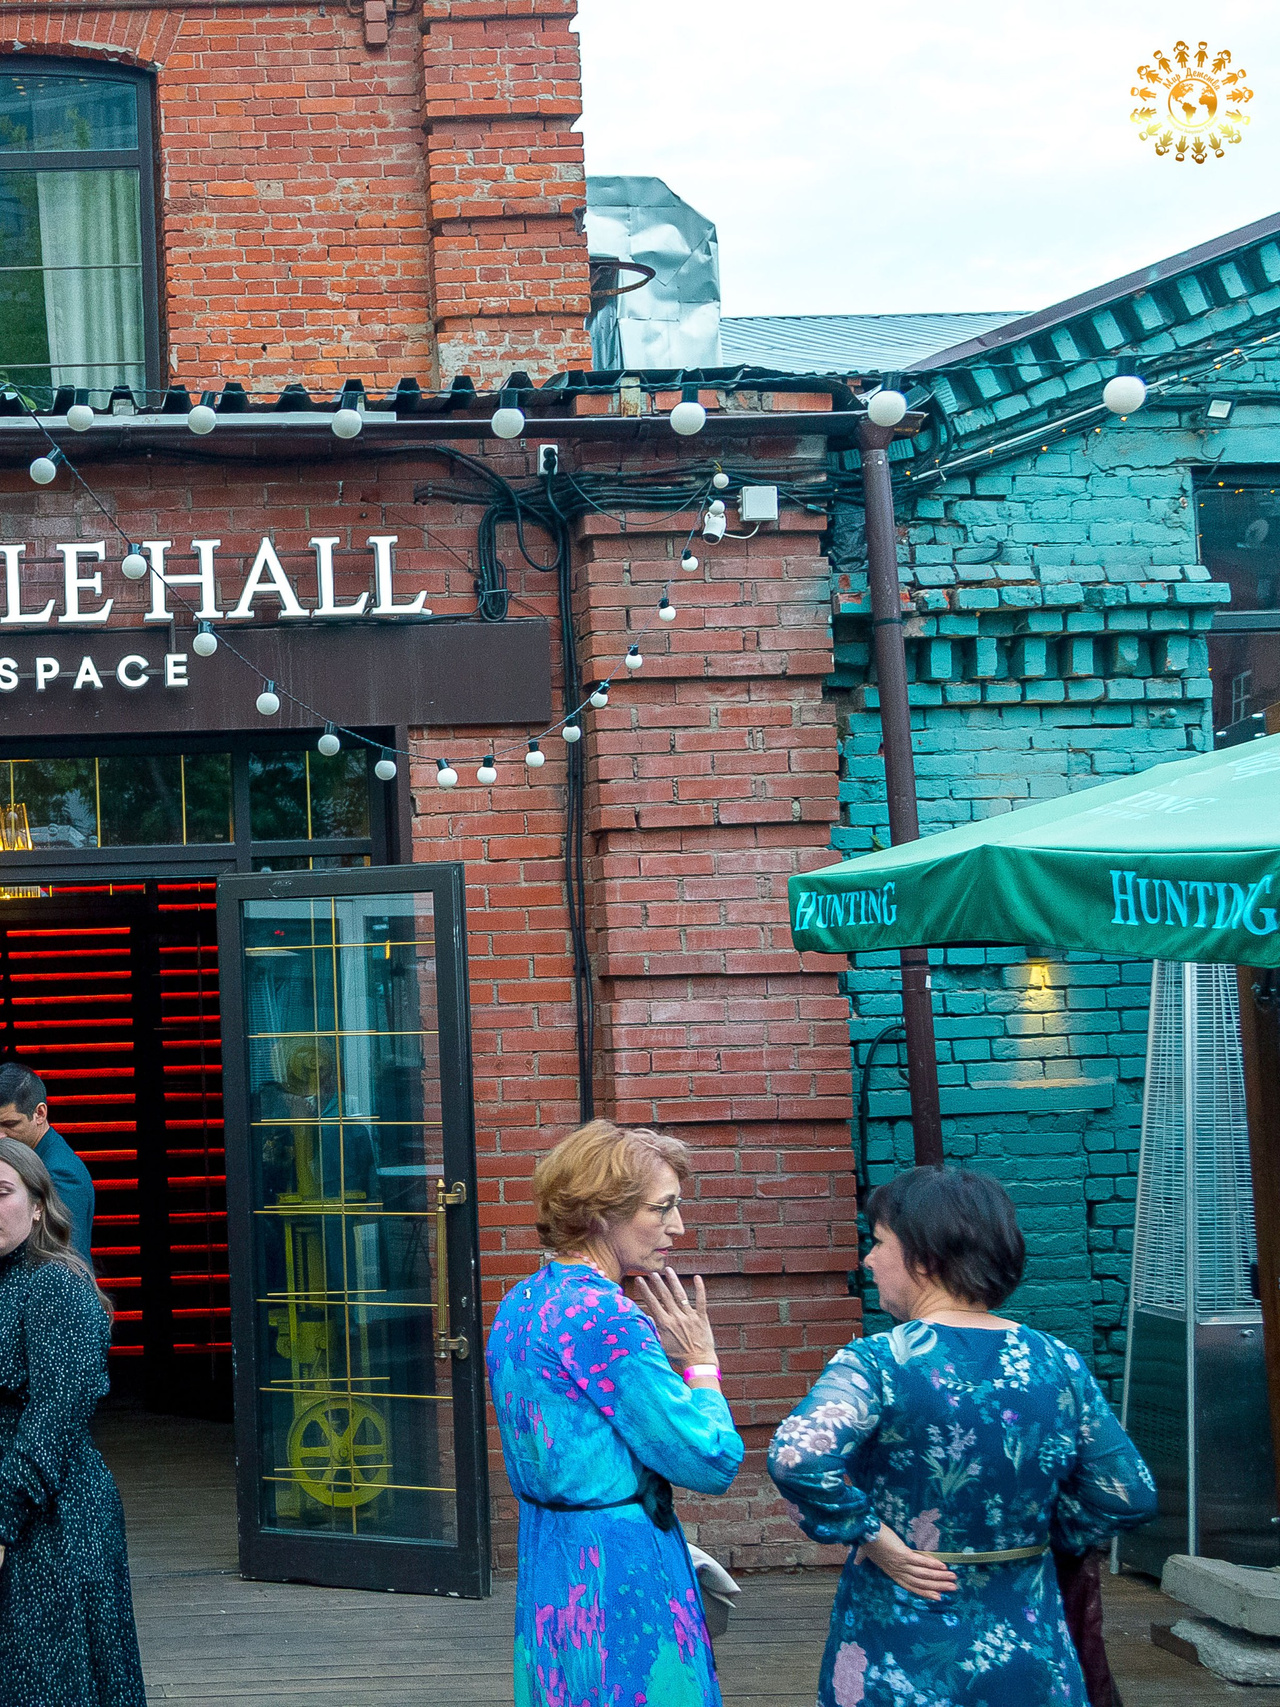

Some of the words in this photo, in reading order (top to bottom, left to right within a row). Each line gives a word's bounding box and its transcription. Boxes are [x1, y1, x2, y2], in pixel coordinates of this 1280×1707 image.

[141, 535, 431, 622] HALL
[794, 881, 898, 932] HUNTING
[1107, 869, 1279, 936] HUNTING
